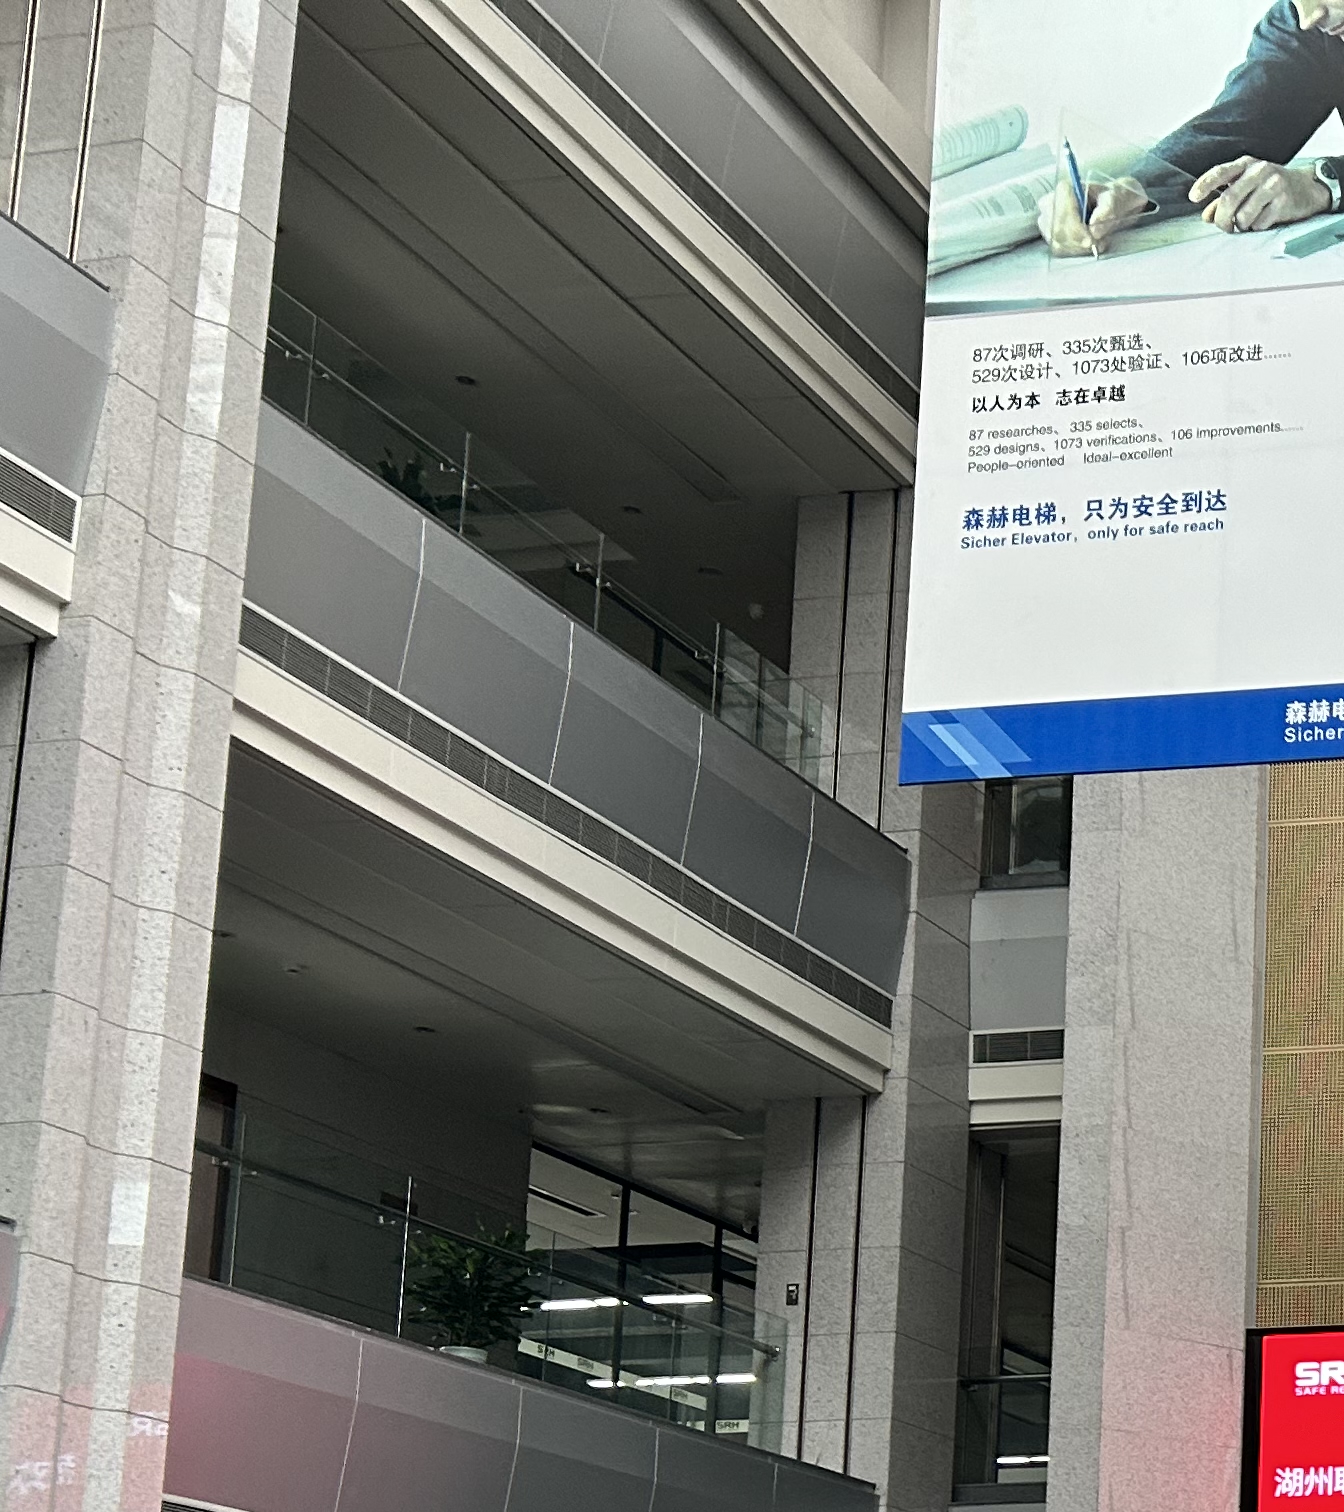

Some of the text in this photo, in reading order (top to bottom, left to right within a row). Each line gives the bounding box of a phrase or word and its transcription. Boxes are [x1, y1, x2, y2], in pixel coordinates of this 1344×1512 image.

[971, 384, 1126, 414] 以人为本 志在卓越
[968, 429, 984, 441] 87
[1069, 420, 1092, 433] 335
[968, 444, 990, 457] 529
[1054, 437, 1083, 451] 1073
[1171, 428, 1193, 441] 106
[960, 535, 1007, 550] Sicher
[1087, 526, 1119, 541] only
[1123, 523, 1145, 537] for
[1149, 520, 1179, 535] safe
[1183, 517, 1224, 533] reach
[1283, 726, 1344, 743] Sicher
[1295, 1385, 1327, 1397] SAFE
[715, 1420, 740, 1431] SRH
